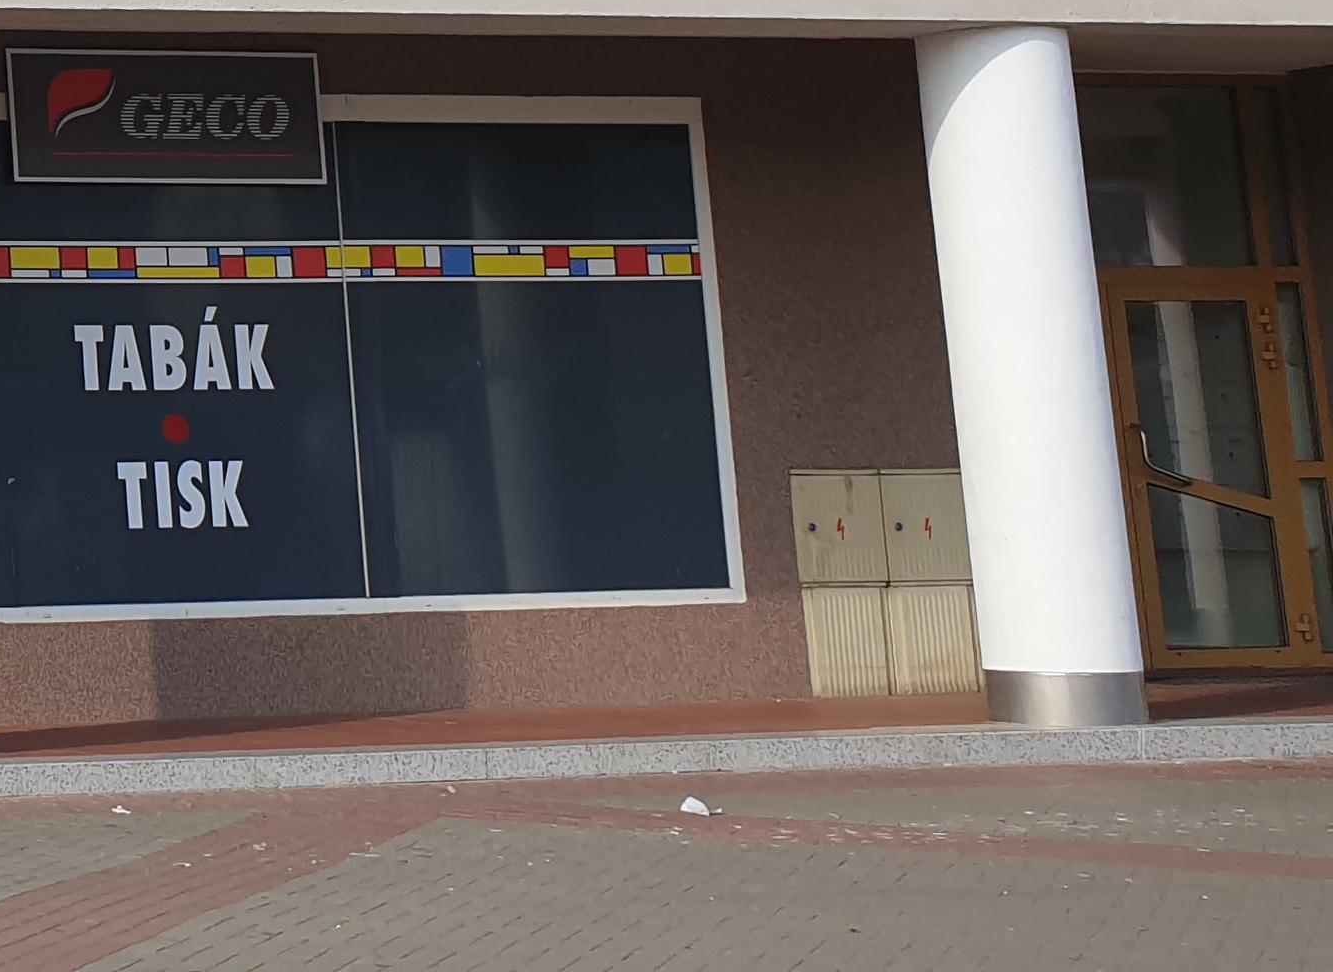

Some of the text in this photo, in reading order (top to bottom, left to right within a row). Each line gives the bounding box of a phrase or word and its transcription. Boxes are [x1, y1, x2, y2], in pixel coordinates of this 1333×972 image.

[119, 93, 292, 141] GECO
[74, 306, 275, 392] TABÁK
[116, 460, 250, 529] TISK
